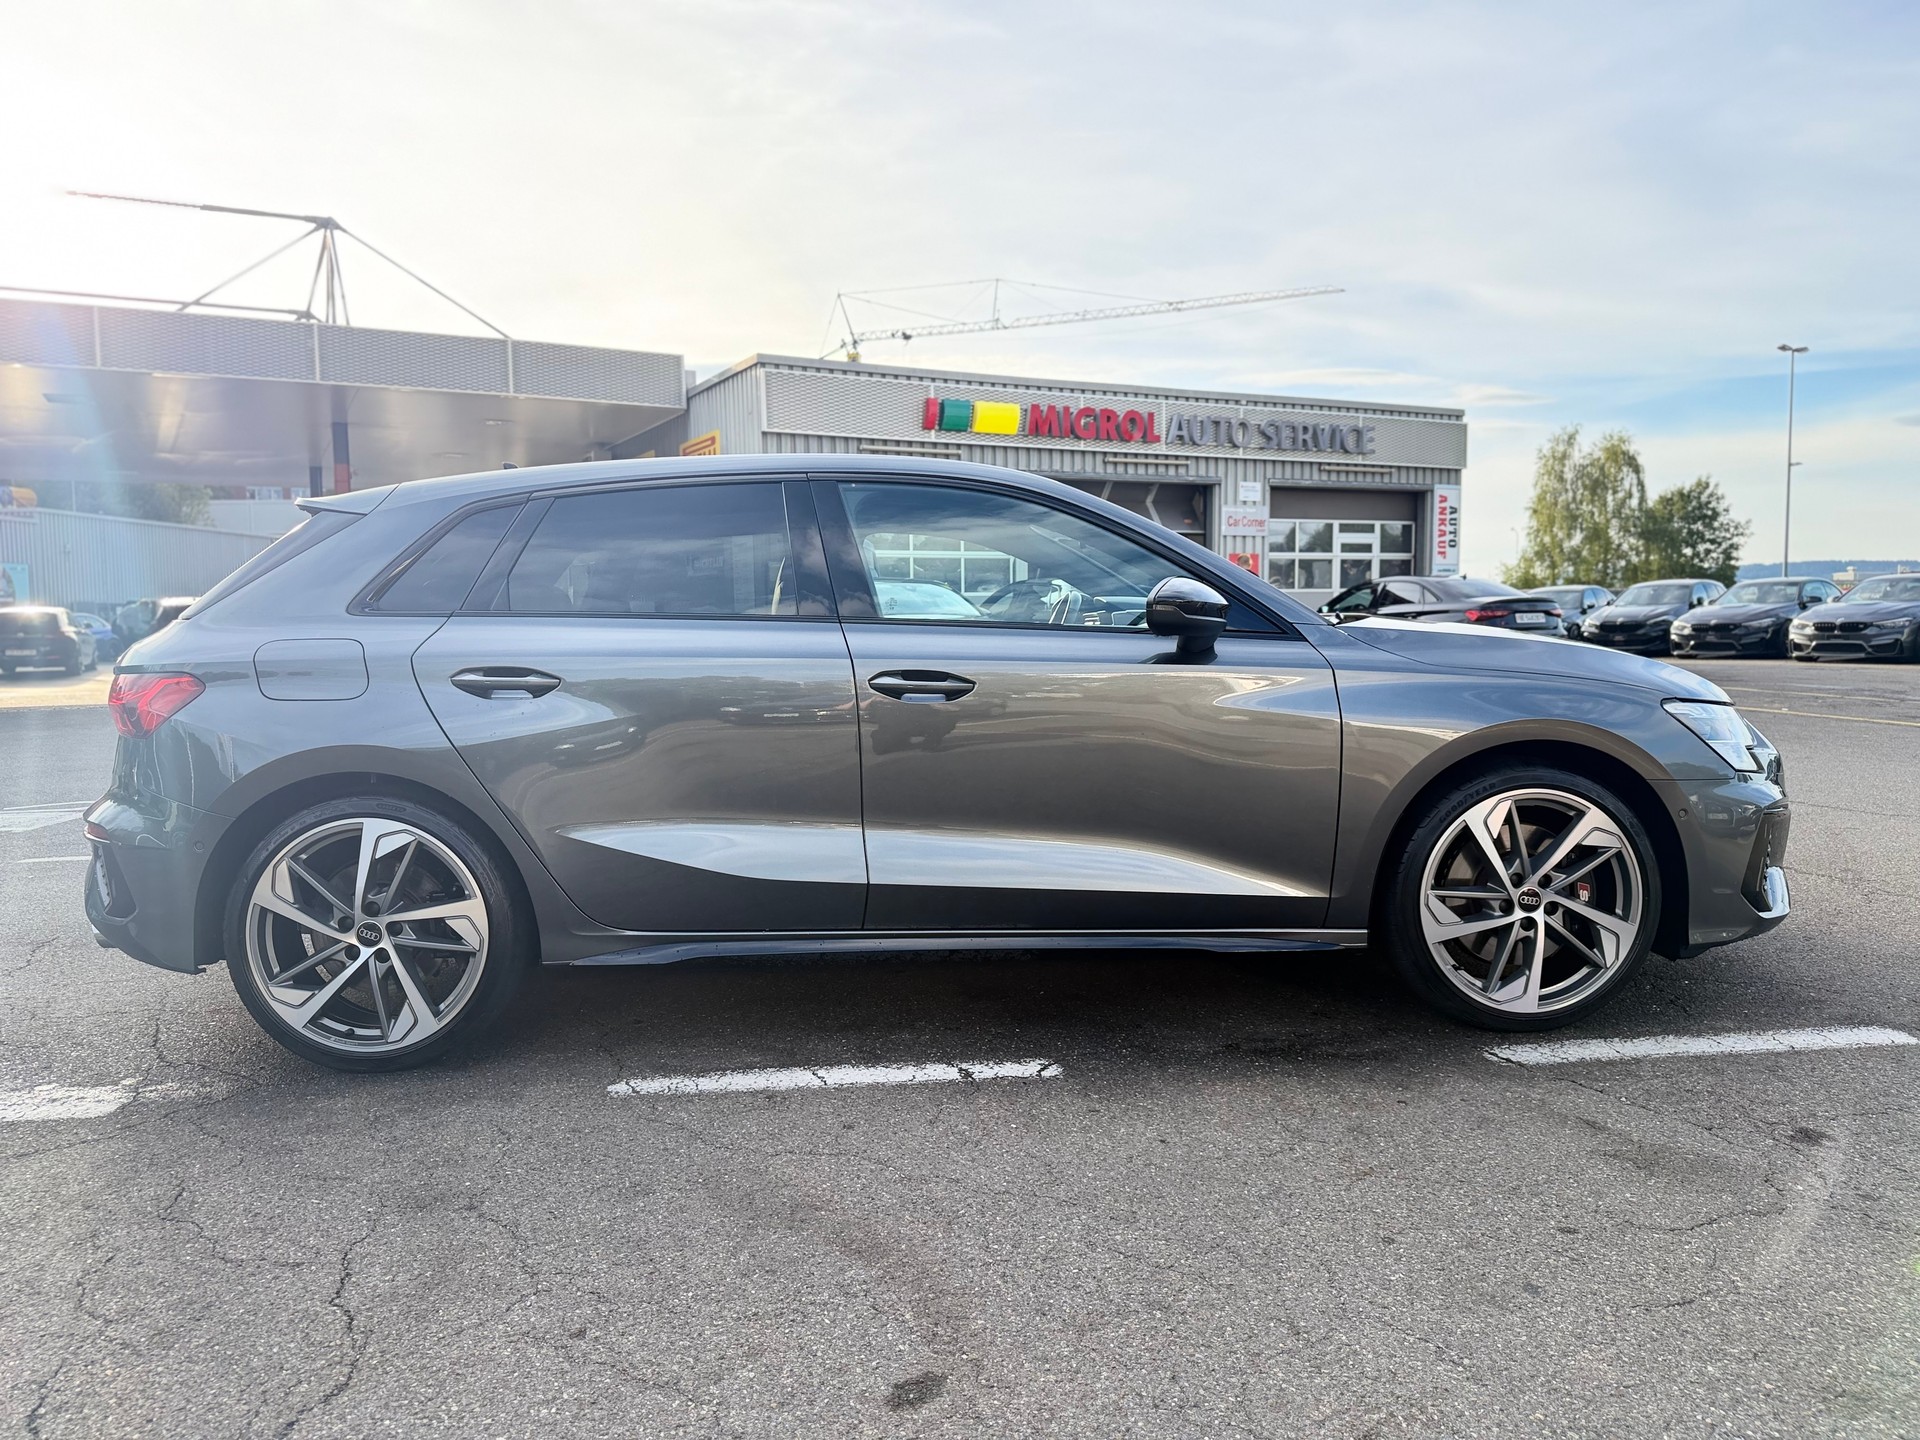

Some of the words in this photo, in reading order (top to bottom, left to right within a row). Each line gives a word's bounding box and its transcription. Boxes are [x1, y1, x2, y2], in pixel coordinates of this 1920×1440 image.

[1027, 403, 1161, 443] MIGROL
[1167, 414, 1251, 448] AUTO
[1260, 419, 1376, 454] SERVICE
[1227, 515, 1241, 528] Car
[1241, 515, 1266, 528] Corner
[1437, 494, 1448, 560] ANKAUF
[1448, 505, 1458, 548] AUTO
